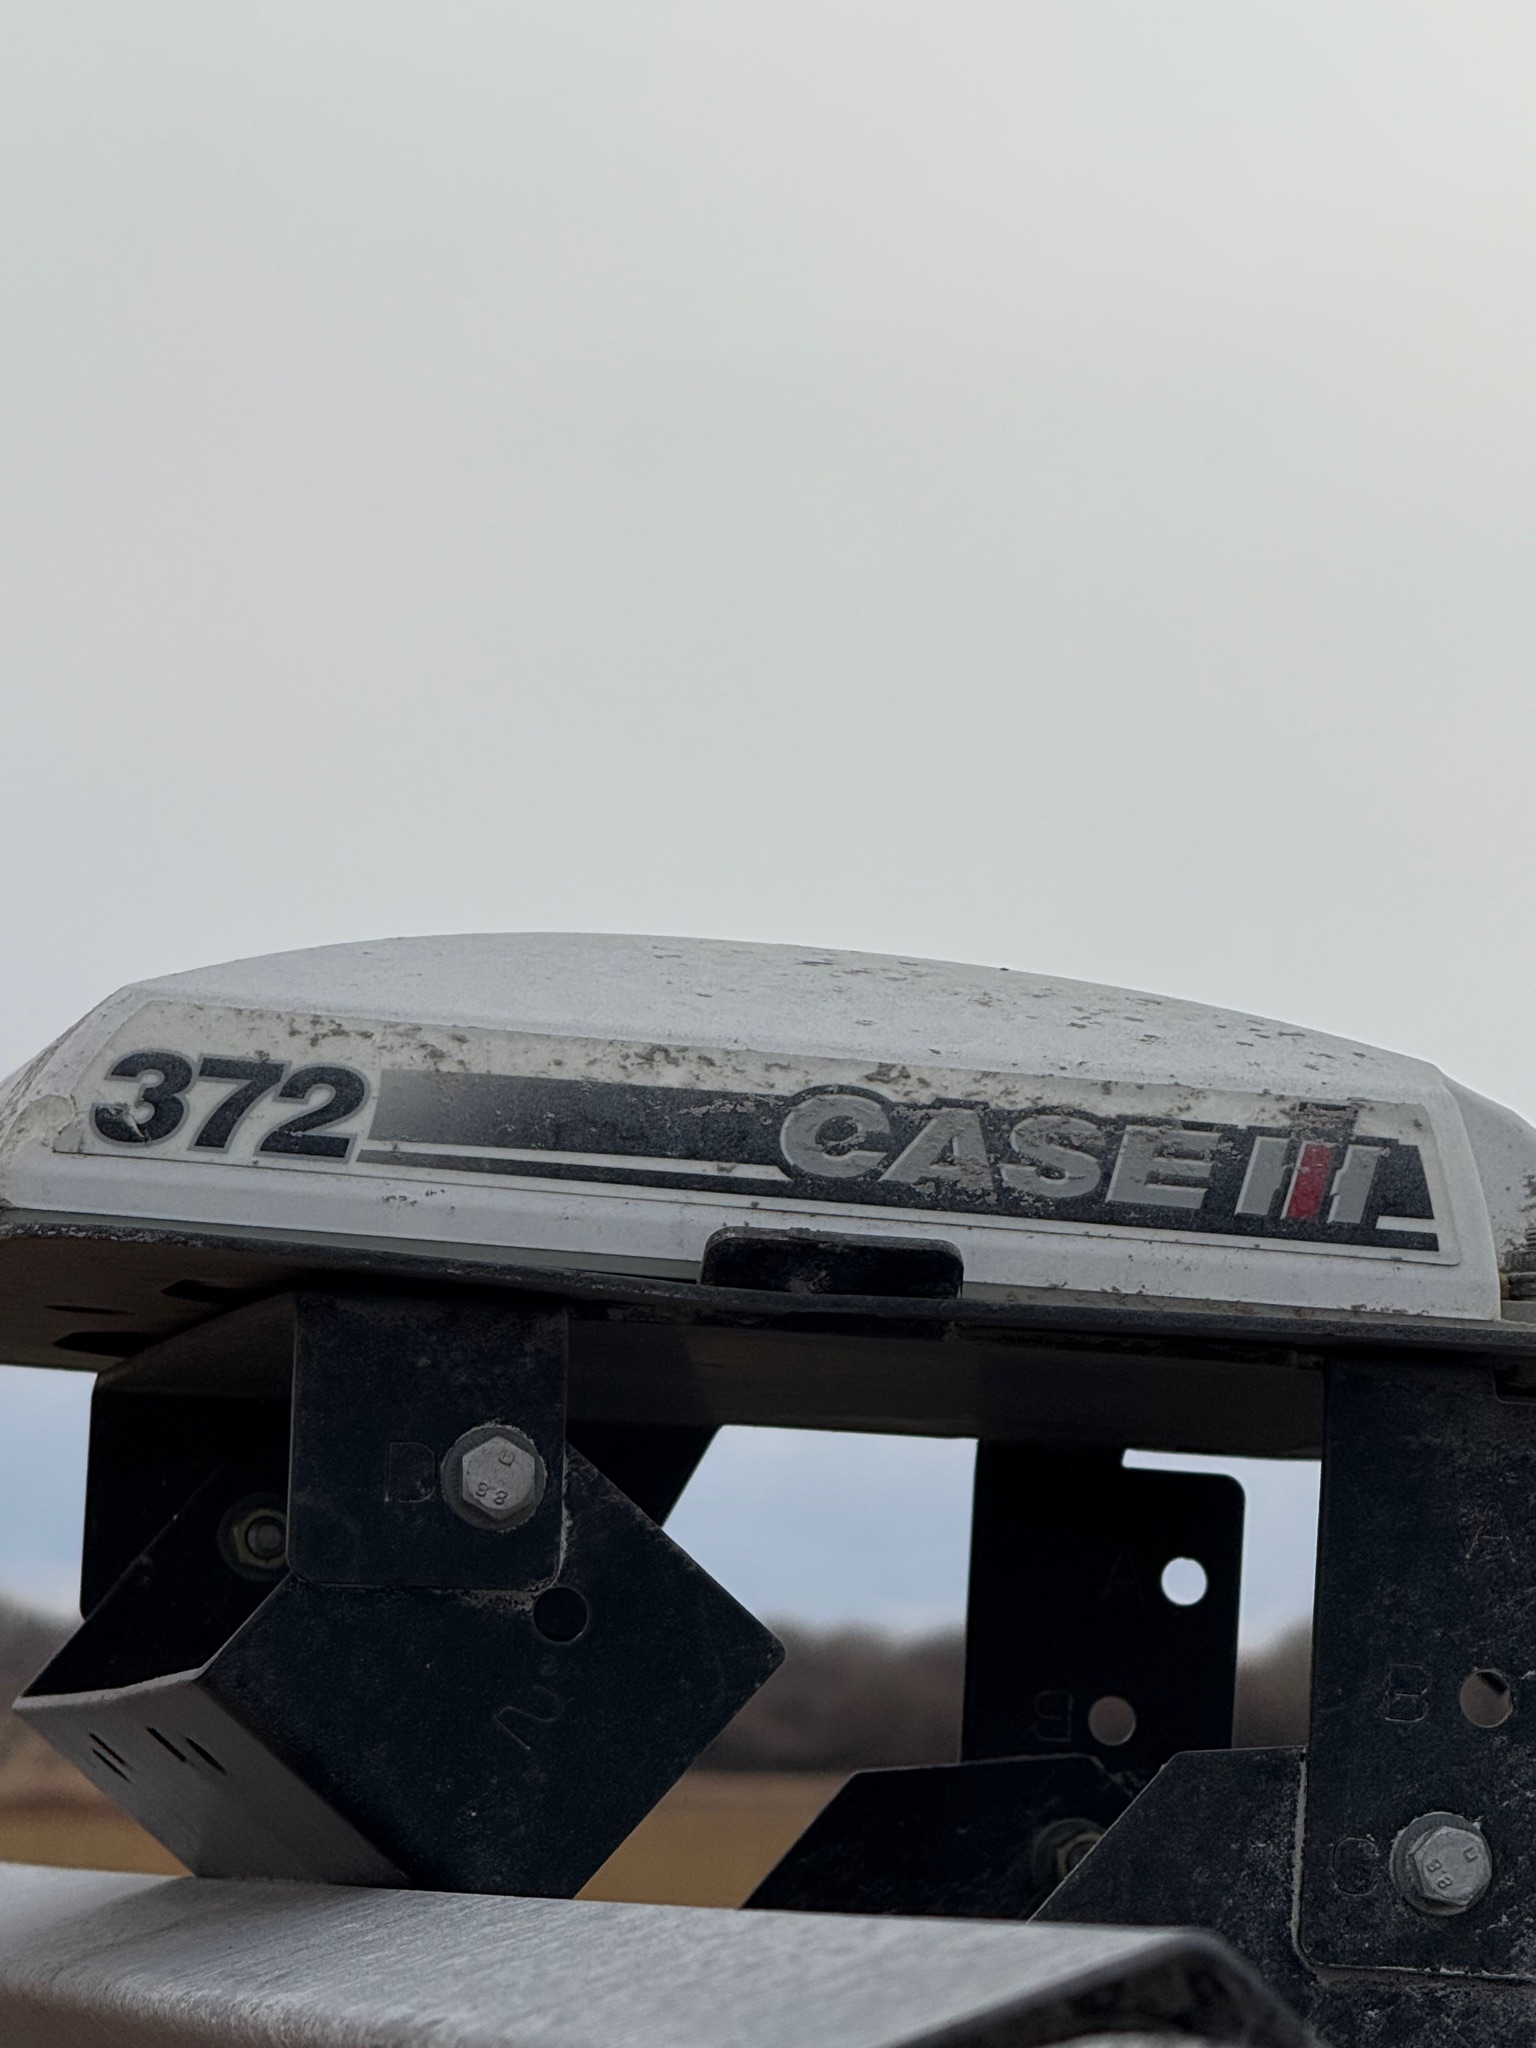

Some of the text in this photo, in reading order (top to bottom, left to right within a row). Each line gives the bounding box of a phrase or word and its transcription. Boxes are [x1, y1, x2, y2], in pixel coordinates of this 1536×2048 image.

[93, 1051, 367, 1159] 372
[779, 1093, 1223, 1210] CASE
[1385, 1663, 1429, 1721] B
